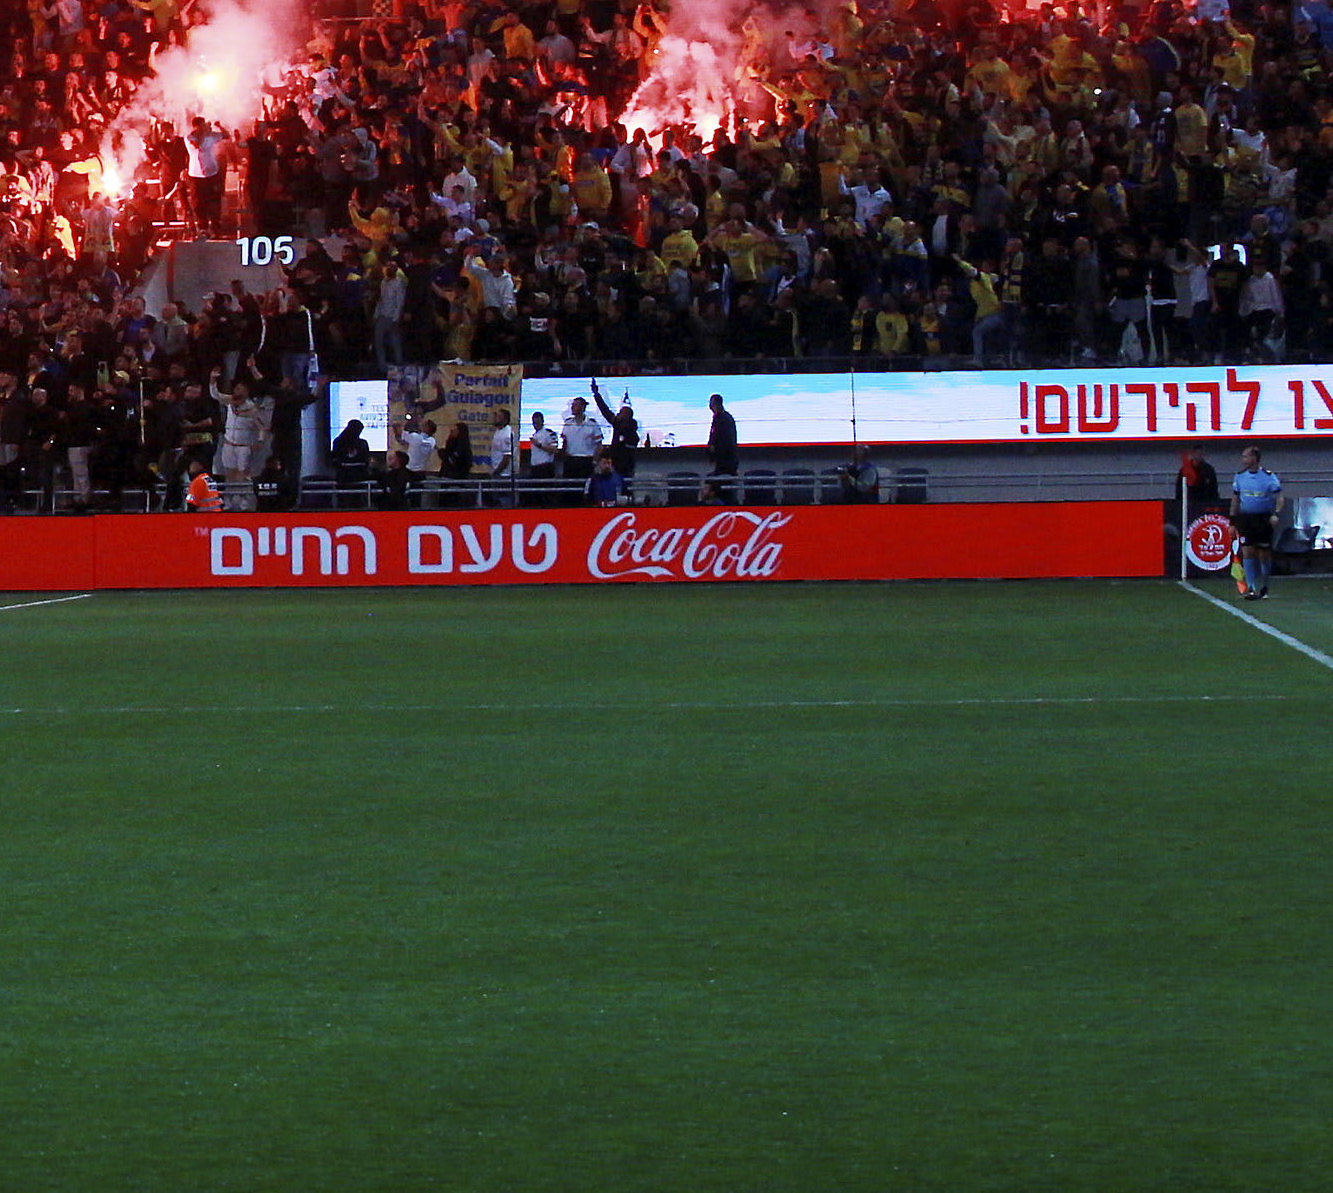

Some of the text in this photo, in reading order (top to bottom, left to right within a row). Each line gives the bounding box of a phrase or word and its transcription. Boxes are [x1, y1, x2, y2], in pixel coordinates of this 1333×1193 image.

[236, 235, 294, 266] 105
[1019, 368, 1261, 435] להירשם!
[210, 525, 377, 575] החיים
[408, 522, 558, 574] טעם
[587, 510, 796, 579] Coca-Cola
